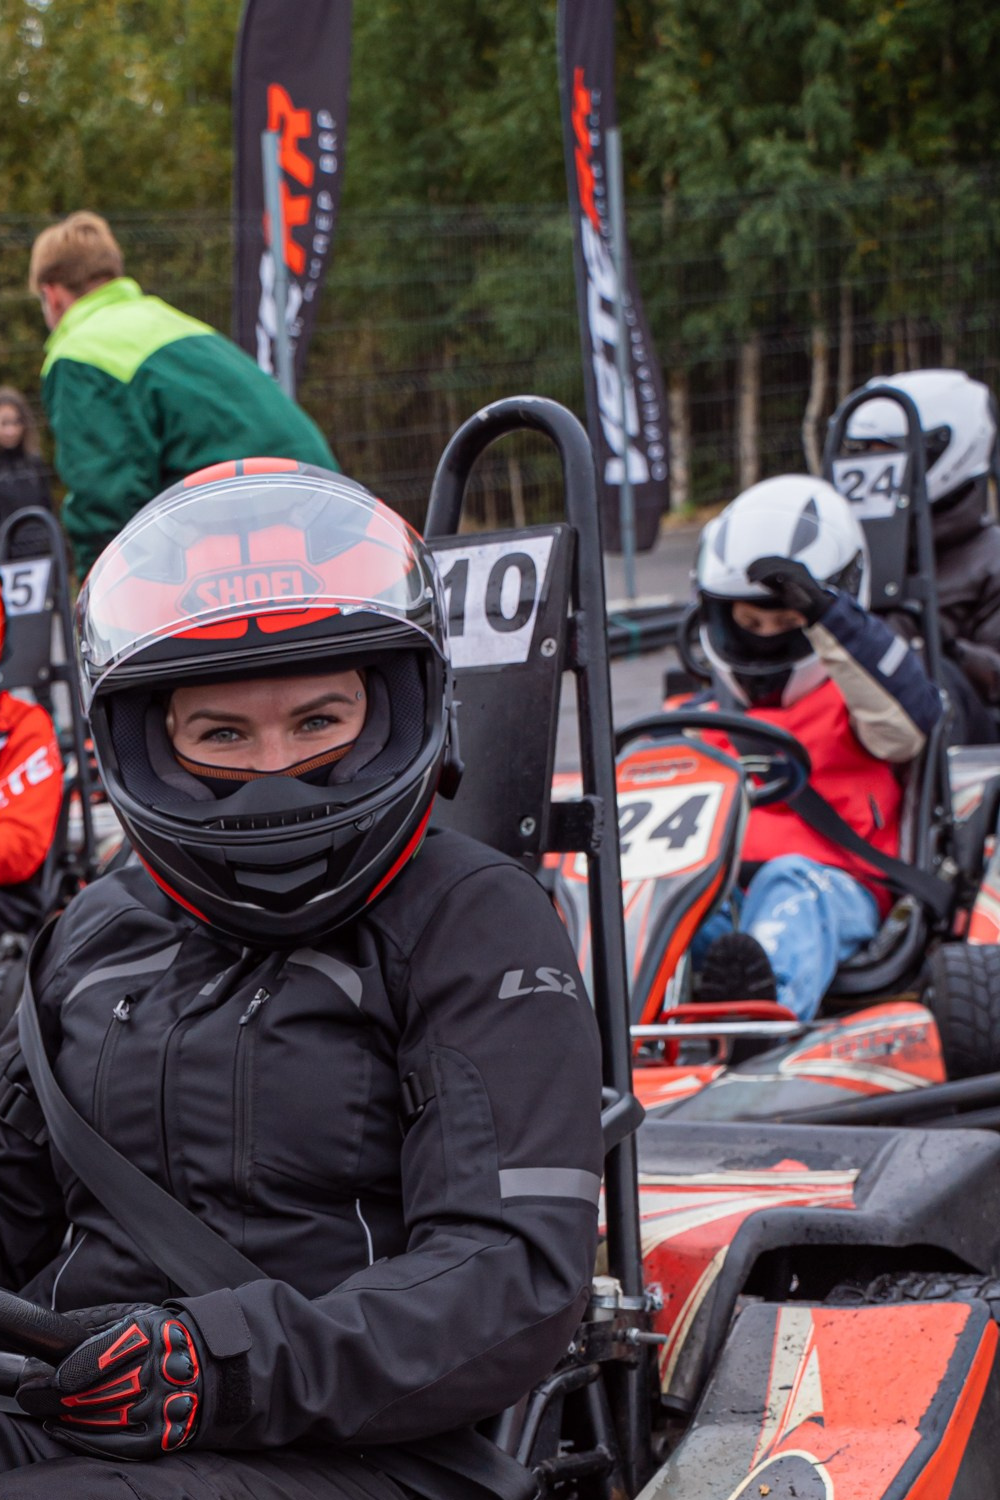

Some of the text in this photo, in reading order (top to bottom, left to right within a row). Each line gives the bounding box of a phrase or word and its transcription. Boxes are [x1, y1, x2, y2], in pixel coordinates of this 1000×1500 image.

[316, 109, 337, 174] BRP
[841, 465, 899, 502] 24
[11, 569, 33, 608] 5
[196, 570, 303, 613] SHOEI
[442, 552, 538, 635] 10
[618, 787, 710, 856] 24
[498, 966, 579, 1001] LS2
